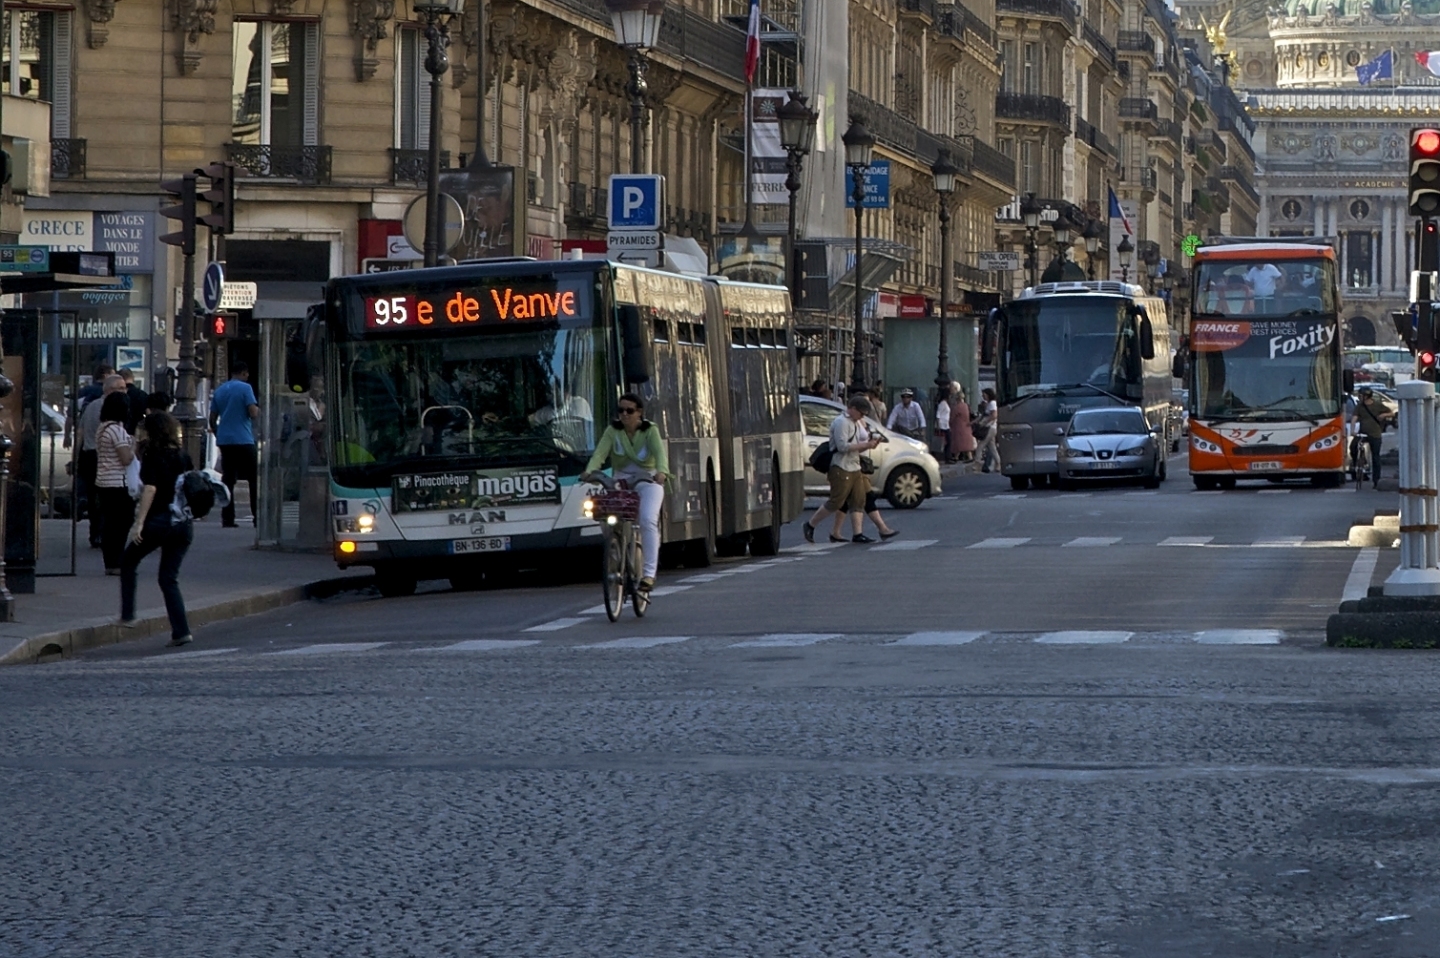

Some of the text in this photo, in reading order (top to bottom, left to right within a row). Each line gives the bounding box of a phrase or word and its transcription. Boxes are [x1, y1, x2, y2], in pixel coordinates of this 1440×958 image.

[846, 166, 889, 175] ECAUDAGE
[862, 184, 879, 193] ANCE
[623, 186, 645, 219] P
[101, 215, 145, 226] VOYAGES
[28, 220, 85, 236] GRECE
[103, 228, 143, 240] DANS LE
[609, 235, 657, 245] PYRAMIDES
[105, 242, 140, 253] MONDE
[3, 250, 13, 258] 95
[979, 252, 1018, 261] ROYAL OPERA
[115, 256, 140, 266] TIER
[82, 292, 126, 304] voyages
[374, 288, 575, 325] 95 e de Vanve
[1194, 323, 1240, 333] FRANCE
[1250, 328, 1269, 336] BEST
[1270, 328, 1297, 336] PRICES
[1270, 323, 1336, 360] Foxity
[414, 474, 469, 488] Pinacothèque
[477, 475, 557, 498] mayas
[448, 510, 506, 525] MAN
